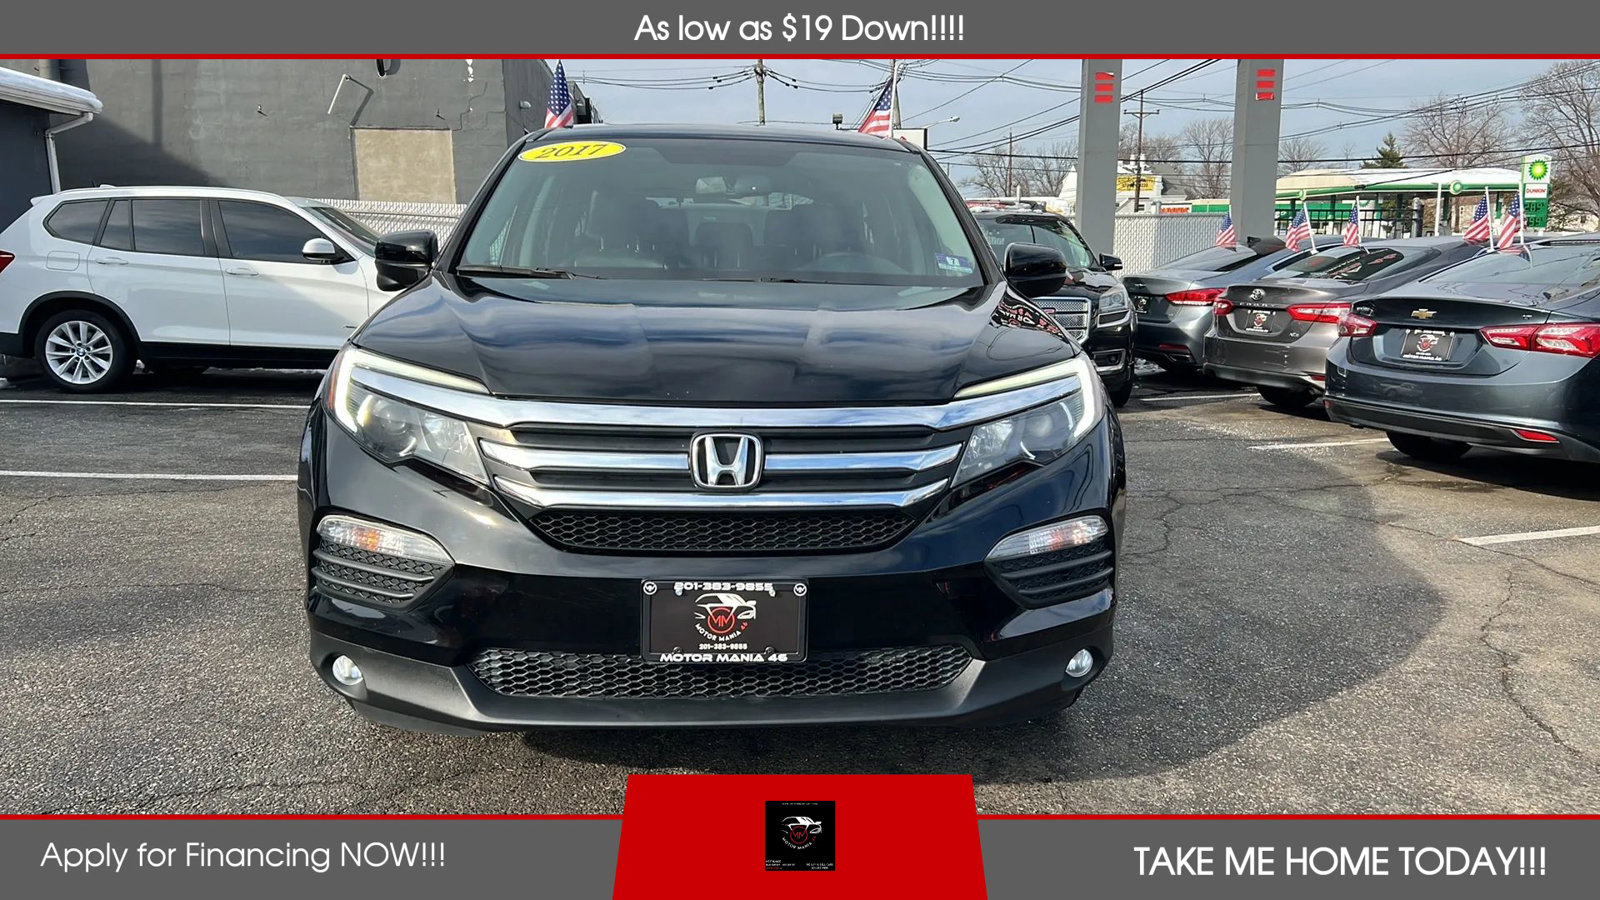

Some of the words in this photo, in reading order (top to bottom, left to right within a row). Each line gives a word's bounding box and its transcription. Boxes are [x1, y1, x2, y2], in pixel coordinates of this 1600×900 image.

[535, 143, 608, 159] 2017
[673, 582, 773, 591] 201-383-9855
[695, 623, 717, 641] MOTOR
[718, 630, 741, 641] MANIA
[660, 653, 712, 662] MOTOR
[716, 653, 764, 662] MANIA
[767, 653, 788, 662] 46
